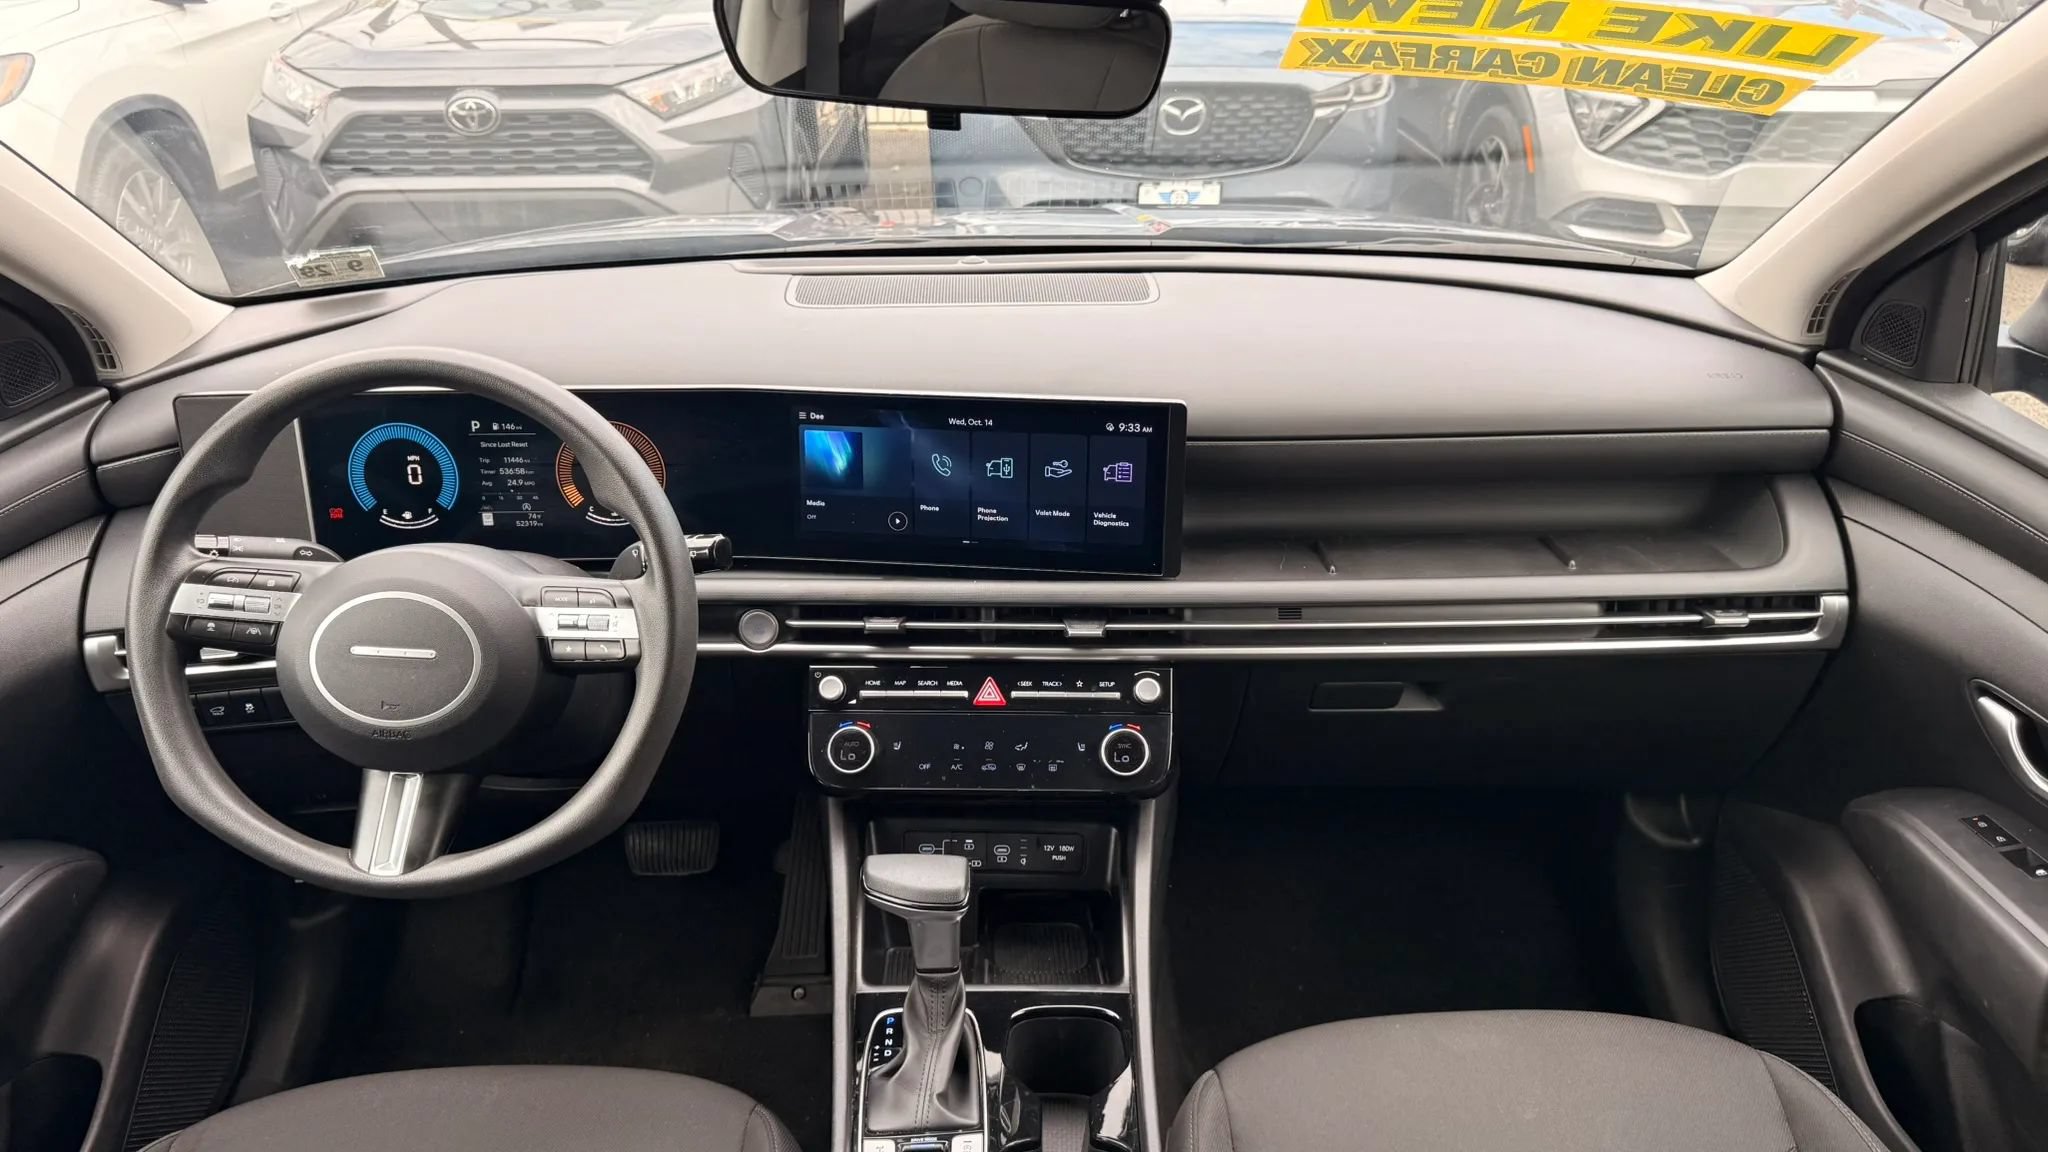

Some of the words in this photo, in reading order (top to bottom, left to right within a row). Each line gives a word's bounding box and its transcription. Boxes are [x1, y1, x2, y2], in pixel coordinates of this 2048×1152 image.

[471, 420, 480, 432] P
[948, 417, 967, 426] Wed,
[968, 418, 983, 426] Oct.
[1118, 422, 1141, 433] 9:33
[407, 464, 422, 485] 0
[919, 504, 940, 512] Phone
[977, 514, 1009, 523] Projection
[1093, 511, 1117, 519] Vehicle
[1093, 519, 1130, 528] Diagnostics
[1043, 844, 1055, 852] 12V
[886, 1016, 895, 1025] P
[885, 1027, 894, 1035] R
[884, 1038, 893, 1046] N
[883, 1049, 892, 1057] D
